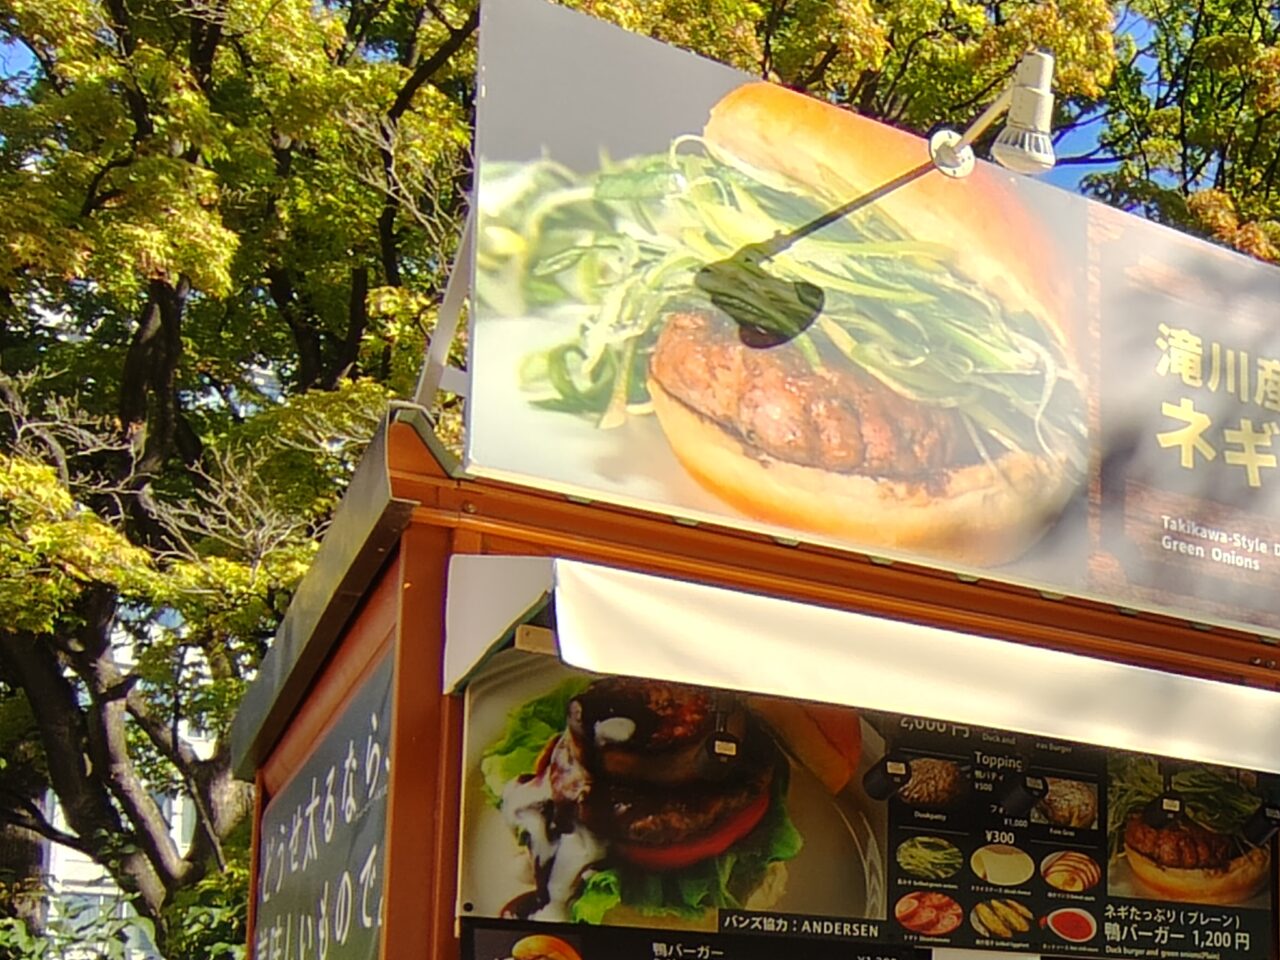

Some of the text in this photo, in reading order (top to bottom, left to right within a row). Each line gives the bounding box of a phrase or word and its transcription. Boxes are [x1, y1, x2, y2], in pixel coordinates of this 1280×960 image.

[1161, 515, 1268, 554] Takikawa-Style
[1161, 535, 1261, 571] Green Onions
[985, 830, 1015, 845] ¥300
[801, 920, 879, 938] ANDERSEN
[1104, 922, 1185, 945] 鴨バーガー
[653, 942, 724, 959] 鴨バーガー
